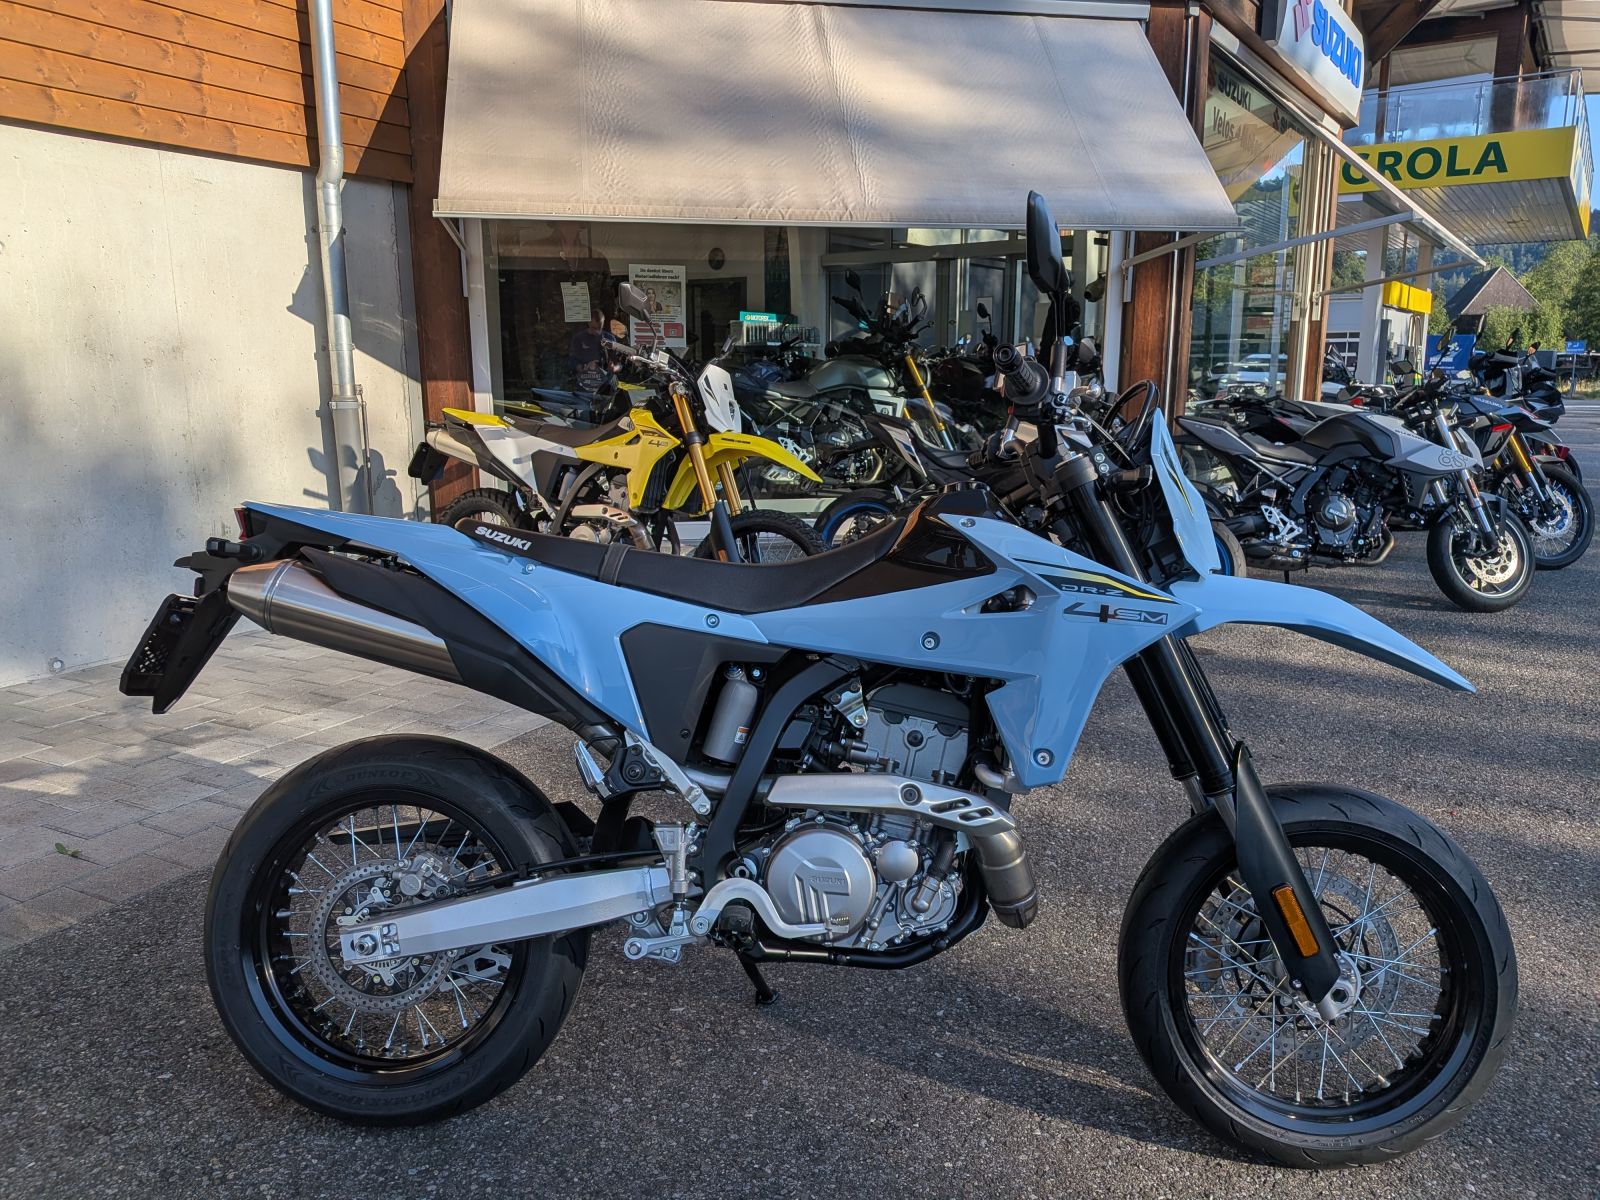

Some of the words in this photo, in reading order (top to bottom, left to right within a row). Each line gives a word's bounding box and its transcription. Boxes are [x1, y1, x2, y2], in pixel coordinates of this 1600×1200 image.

[1312, 0, 1362, 88] SUZUKI
[1217, 72, 1251, 112] SUZUKI
[1213, 106, 1235, 139] Velos
[474, 525, 532, 551] SUZUKI
[1060, 583, 1124, 597] DR-Z
